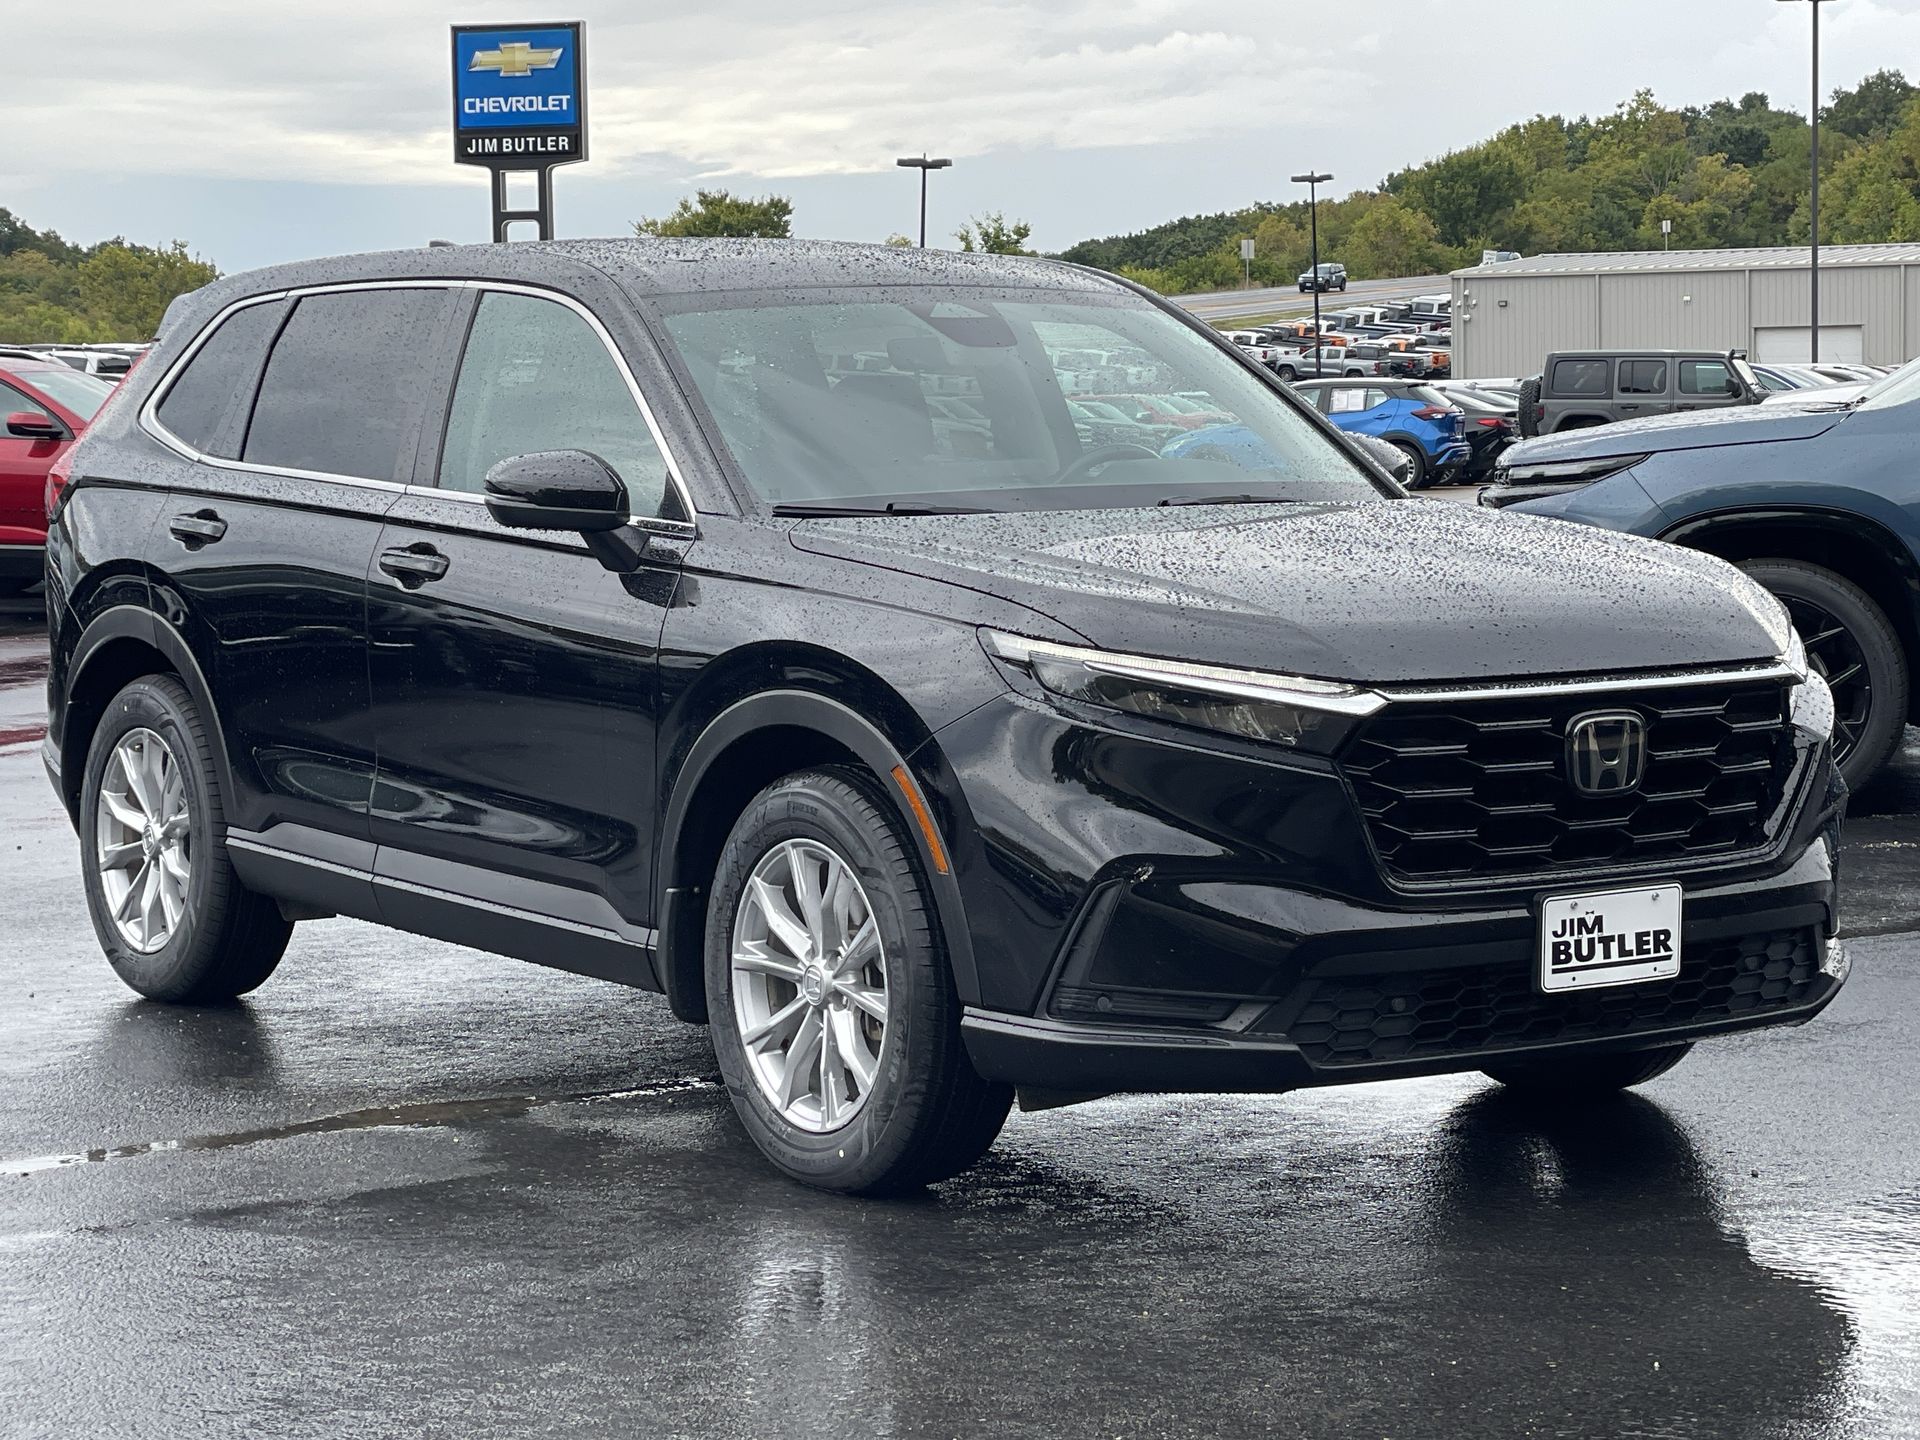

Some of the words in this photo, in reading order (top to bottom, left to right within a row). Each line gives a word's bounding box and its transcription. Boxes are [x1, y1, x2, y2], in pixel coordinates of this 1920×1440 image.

[464, 95, 570, 113] CHEVROLET
[467, 138, 497, 153] JIM
[502, 136, 569, 152] BUTLER
[1552, 915, 1604, 938] JIM
[1552, 929, 1673, 966] BUTLER
